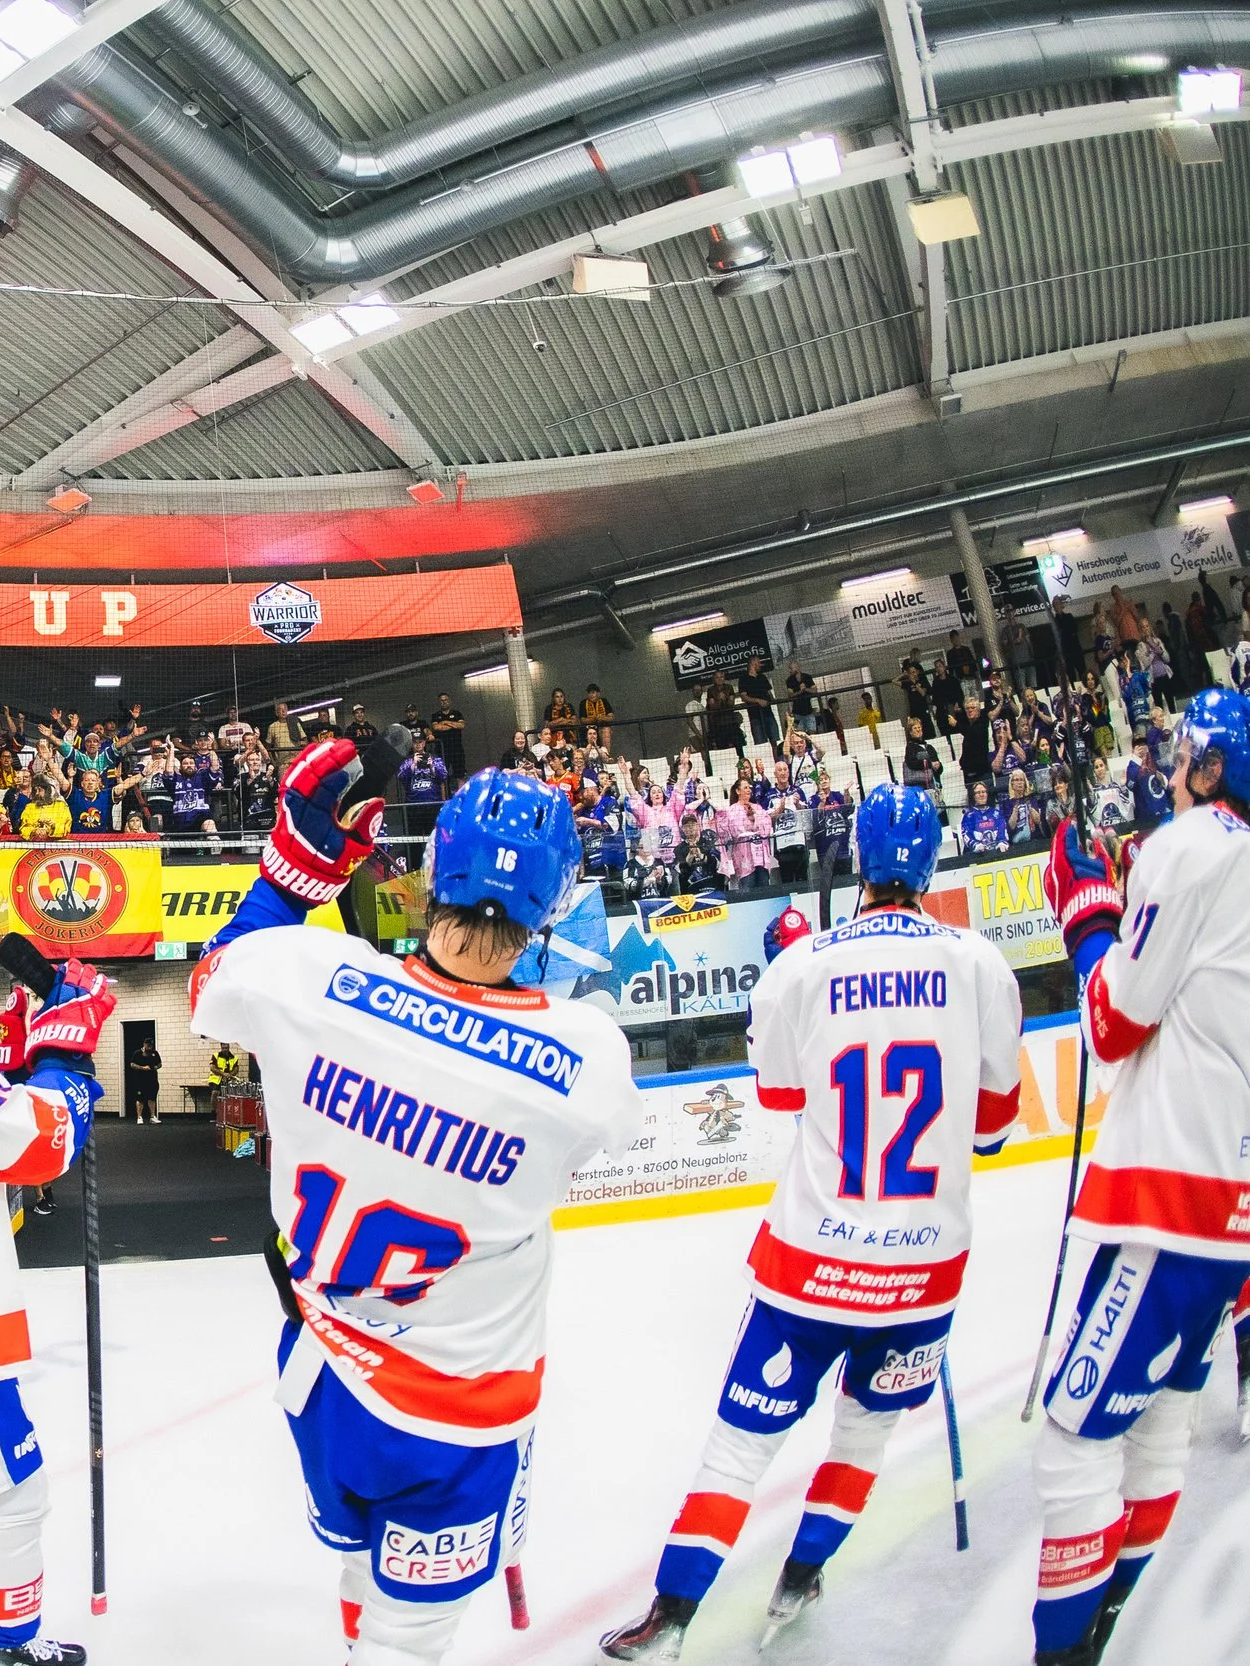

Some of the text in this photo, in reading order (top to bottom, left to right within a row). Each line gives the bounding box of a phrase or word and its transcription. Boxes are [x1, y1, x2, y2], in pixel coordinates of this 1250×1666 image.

[1076, 552, 1129, 572] Hirschvogel
[1081, 559, 1161, 586] Automotive Group
[252, 604, 319, 622] WARRIOR
[852, 590, 926, 620] mouldtec
[705, 645, 766, 668] Bauprofis
[708, 639, 750, 656] Allgäuer
[496, 847, 518, 873] 16
[896, 847, 909, 862] 12
[973, 863, 1044, 920] TAXI
[35, 919, 105, 940] JOKERIT
[655, 906, 723, 928] SCOTLAND
[1006, 920, 1034, 940] SIND
[1025, 936, 1063, 959] 2000
[630, 962, 761, 1016] alpina
[829, 969, 948, 1016] FENENKO
[368, 982, 581, 1091] CIRCULATION
[302, 1054, 527, 1187] HENRITIUS
[829, 1039, 945, 1203] 12
[627, 1166, 634, 1177] 9
[643, 1160, 679, 1175] 87600
[681, 1152, 748, 1170] Neugablonz
[817, 1217, 942, 1248] EAT & ENJOY
[813, 1262, 931, 1286] Itä-Vantaan
[802, 1281, 926, 1306] Rakennus Oy
[1090, 1263, 1137, 1354] HALTI
[881, 1339, 948, 1372] CABLE
[875, 1360, 940, 1390] CREW
[727, 1381, 800, 1418] INFUEL
[385, 1519, 496, 1559] CABLE
[385, 1547, 488, 1581] CREW
